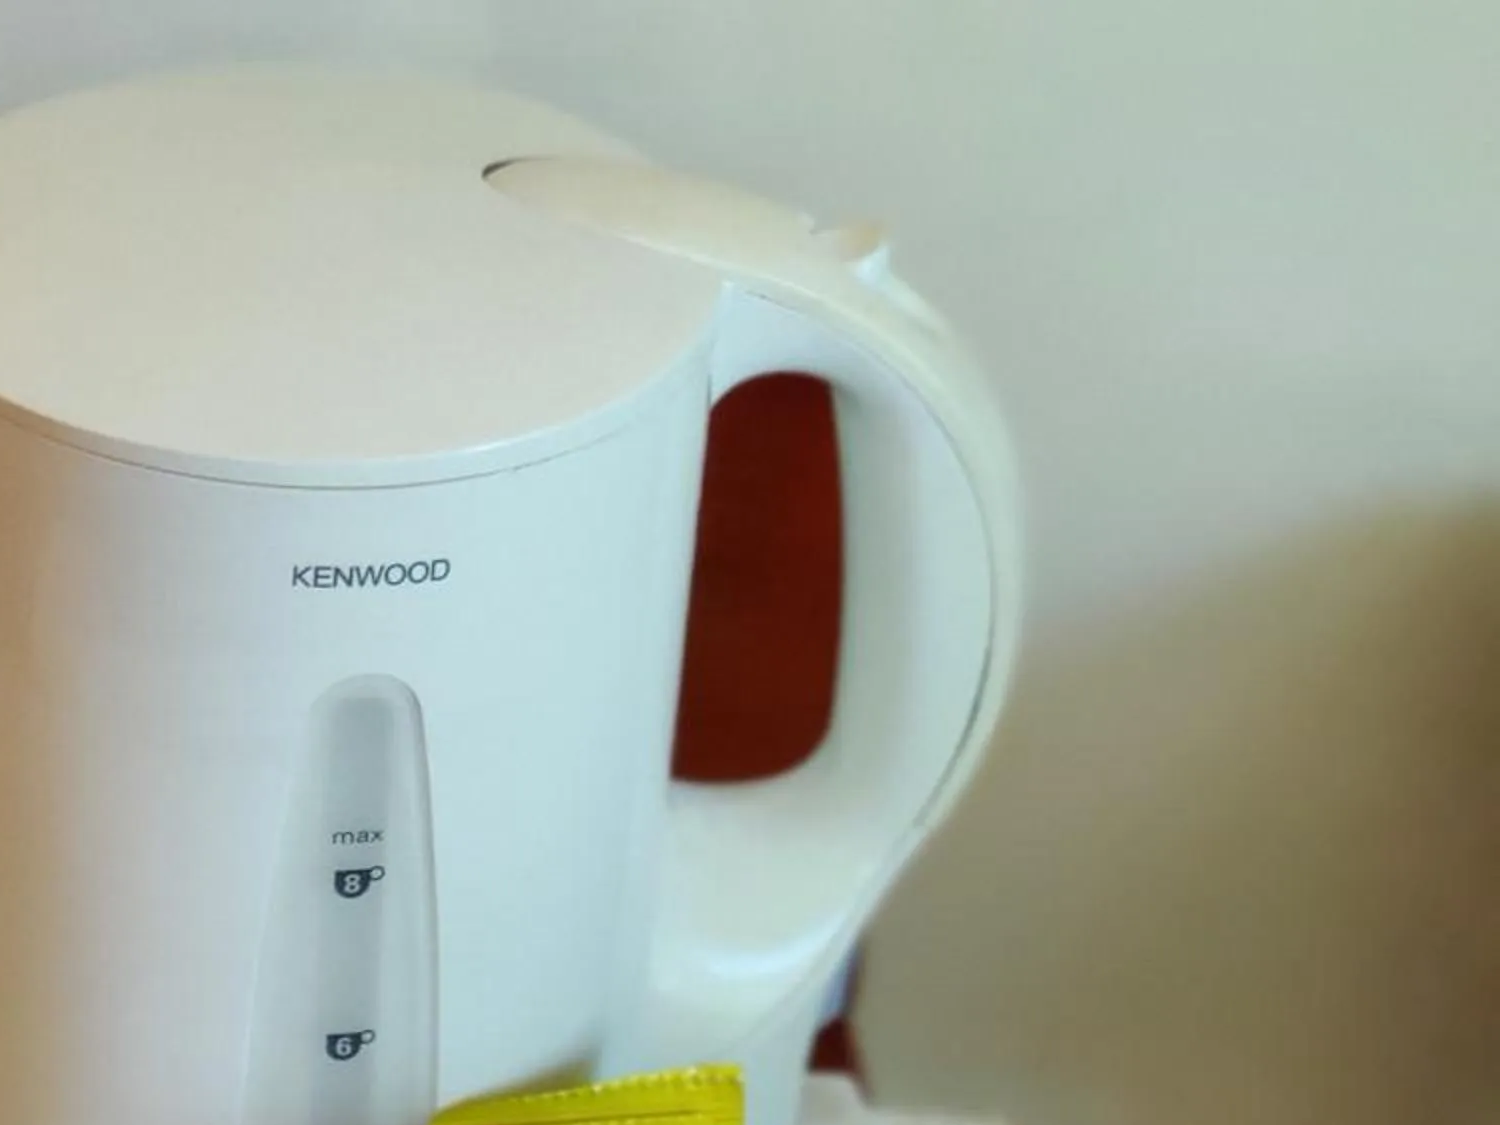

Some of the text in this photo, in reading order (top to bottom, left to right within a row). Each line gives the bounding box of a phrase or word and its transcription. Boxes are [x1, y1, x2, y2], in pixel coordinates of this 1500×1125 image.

[291, 558, 451, 588] KENWOOD
[332, 828, 385, 845] max
[344, 873, 361, 894] 8
[336, 1037, 352, 1057] 6
